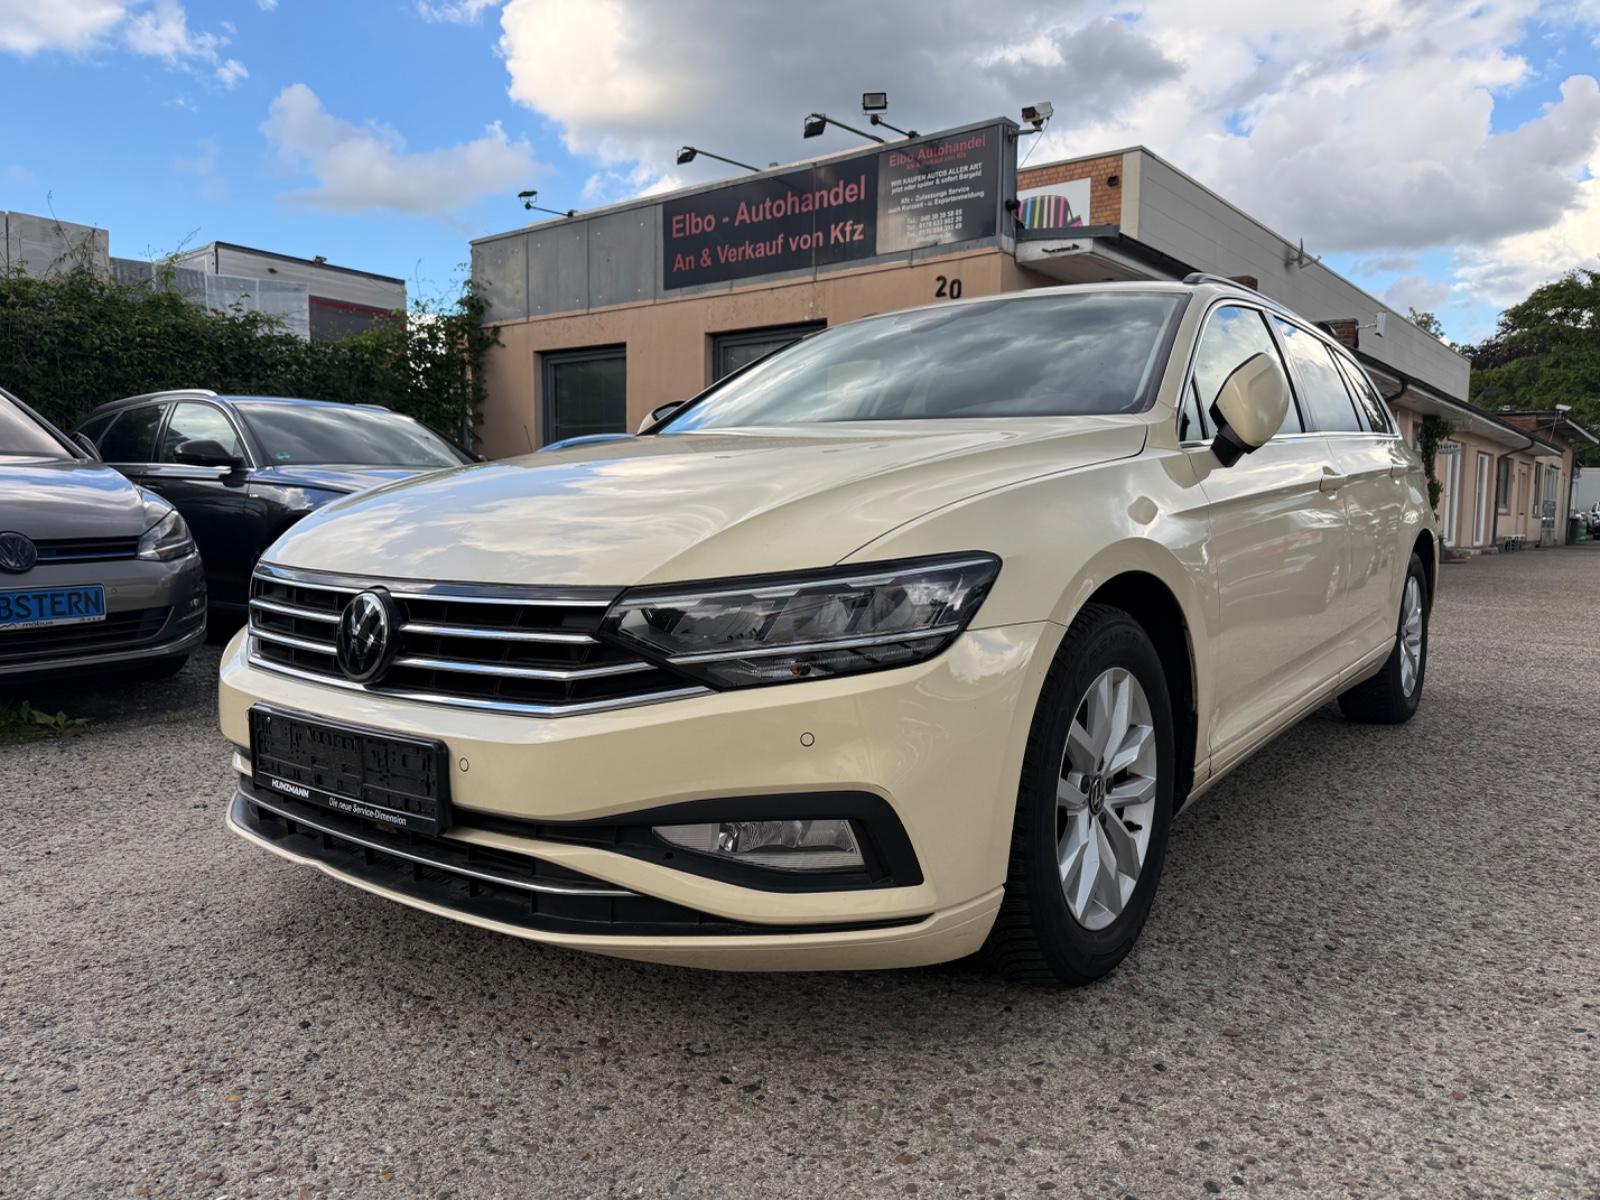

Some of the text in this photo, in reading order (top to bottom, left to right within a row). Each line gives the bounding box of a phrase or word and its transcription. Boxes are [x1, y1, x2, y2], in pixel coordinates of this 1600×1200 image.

[889, 135, 986, 167] Elbo Autohandel
[903, 173, 926, 185] KAUFEN
[927, 169, 947, 180] AUTOS
[949, 165, 968, 176] ALLER
[969, 162, 983, 172] ART
[941, 174, 958, 184] sofort
[959, 170, 982, 181] Bargeld
[949, 186, 969, 195] Service
[672, 212, 715, 239] Elbo
[735, 176, 866, 227] Autohandel
[673, 220, 865, 272] An & Verkauf von Kfz
[935, 275, 962, 299] 20
[271, 779, 310, 799] KUNZMANN
[329, 797, 407, 826] Die neue Service-Dimension
